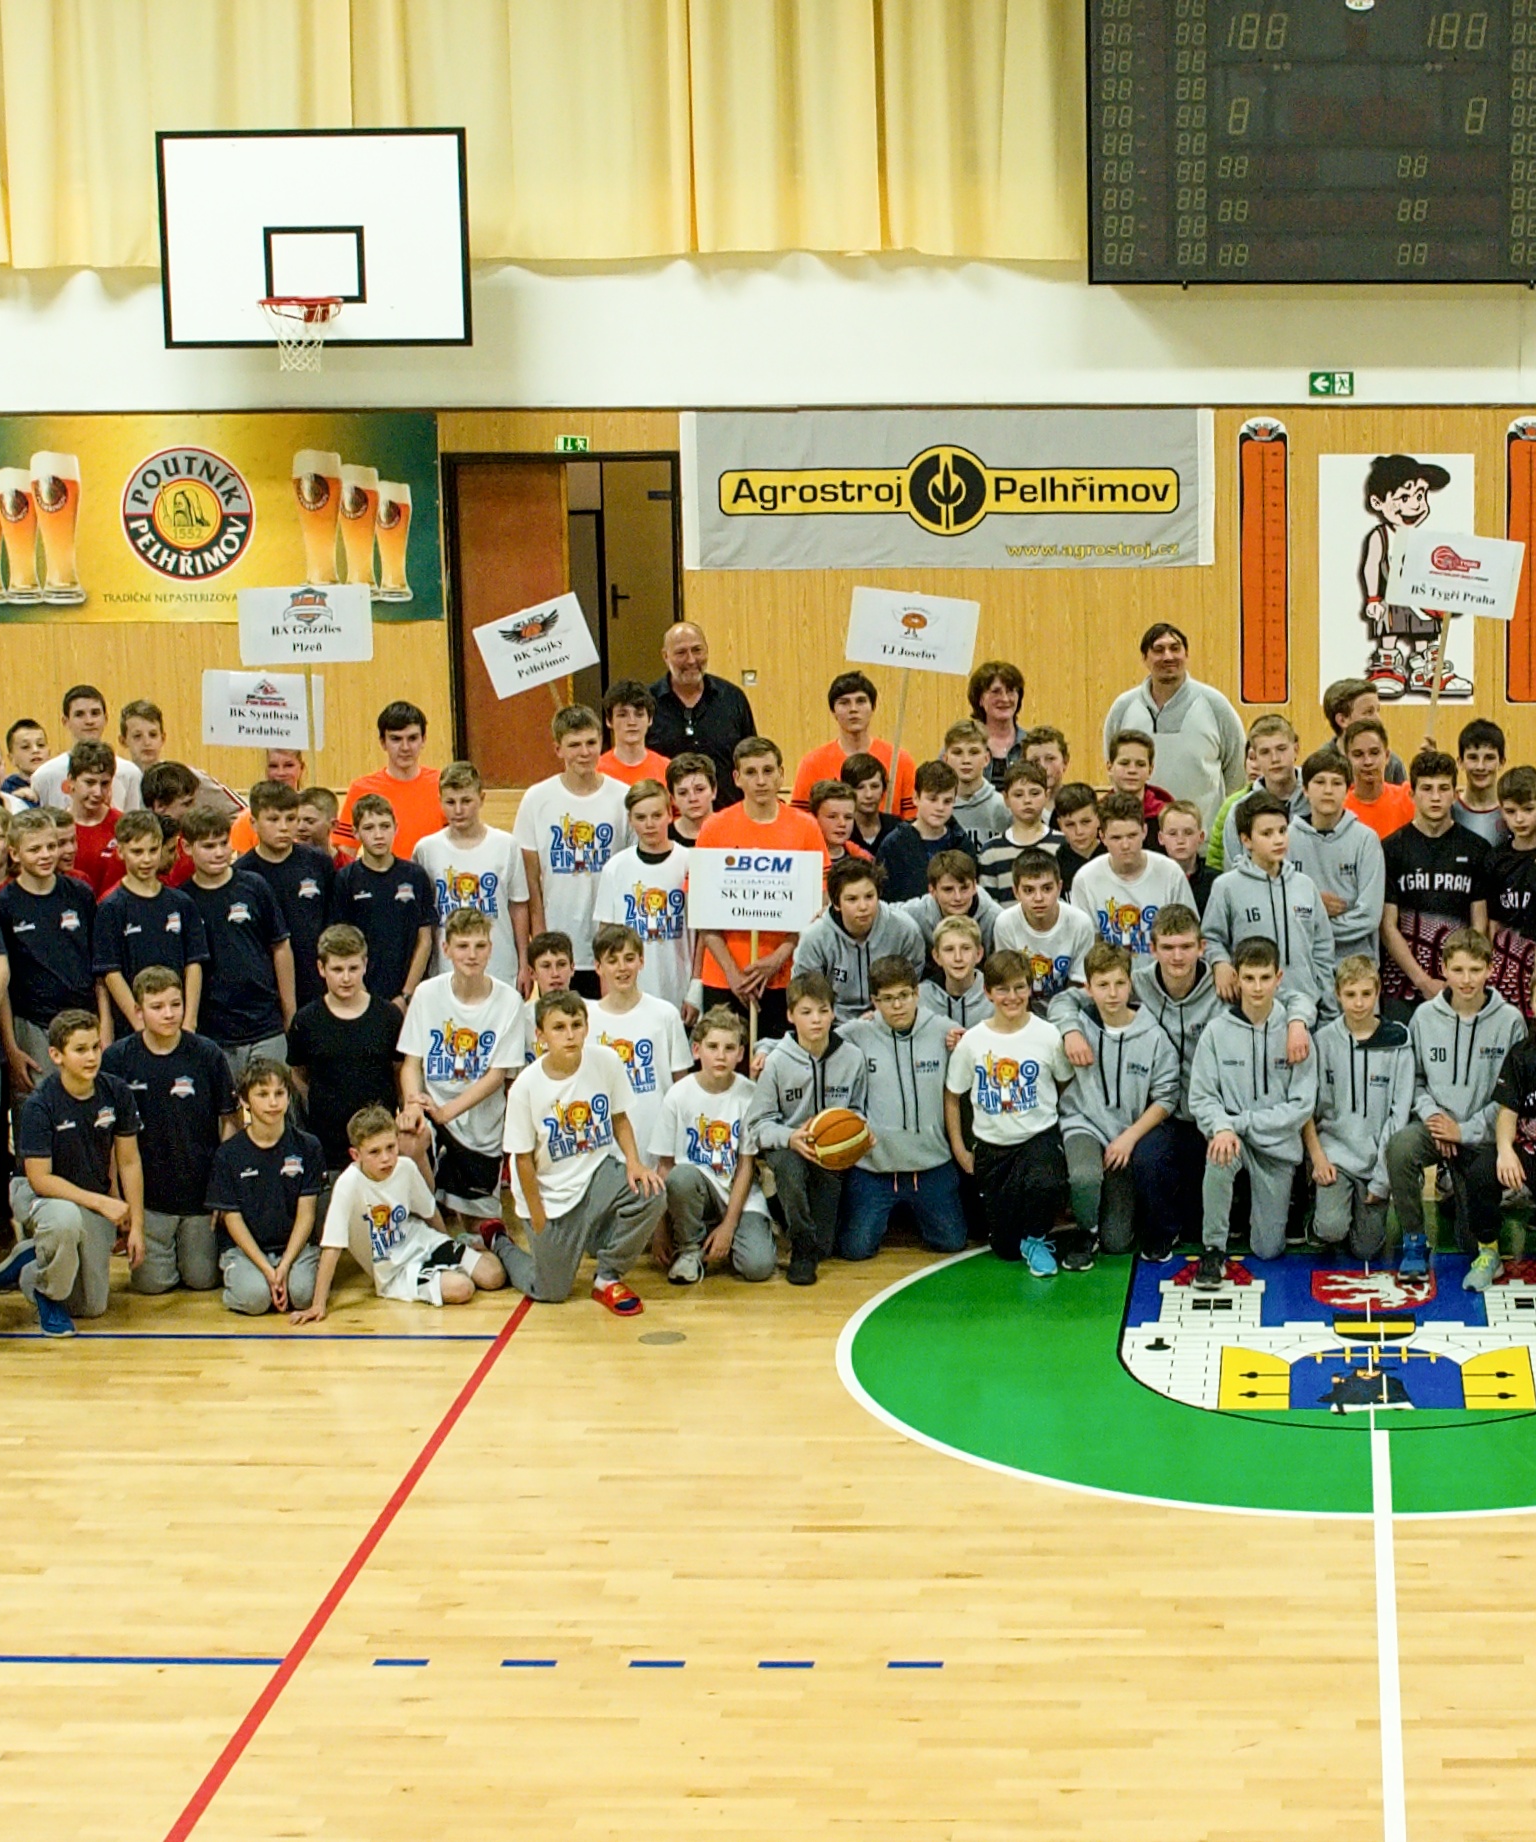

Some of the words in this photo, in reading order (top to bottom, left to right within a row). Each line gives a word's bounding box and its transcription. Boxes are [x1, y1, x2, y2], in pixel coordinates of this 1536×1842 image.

[131, 455, 242, 507] POUTNÍK
[732, 477, 902, 510] Agrostroj
[994, 477, 1170, 503] Pelhřimov
[129, 517, 246, 576] PELHŘIMOV
[1006, 542, 1179, 560] www.agrostroj.cz
[103, 592, 152, 603] TRADIČNÍ
[155, 592, 238, 603] NEPASTERIZOVA
[1429, 586, 1460, 601] Tygři
[1463, 592, 1496, 605] Praha
[292, 624, 342, 635] Grizzlies
[292, 642, 322, 653] Plzeň
[513, 651, 532, 663] BK
[532, 639, 564, 656] Sojky
[898, 646, 937, 660] Josefov
[517, 653, 571, 679] Pelhřimov
[229, 708, 246, 718] BK
[250, 709, 300, 721] Synthesia
[238, 725, 291, 738] Pardubice
[738, 855, 793, 872] BCM
[721, 889, 738, 899] SK
[742, 890, 759, 900] UP
[763, 890, 794, 901] BCM
[731, 907, 783, 918] Olomouc
[1430, 1046, 1447, 1063] 30
[785, 1088, 803, 1101] 20
